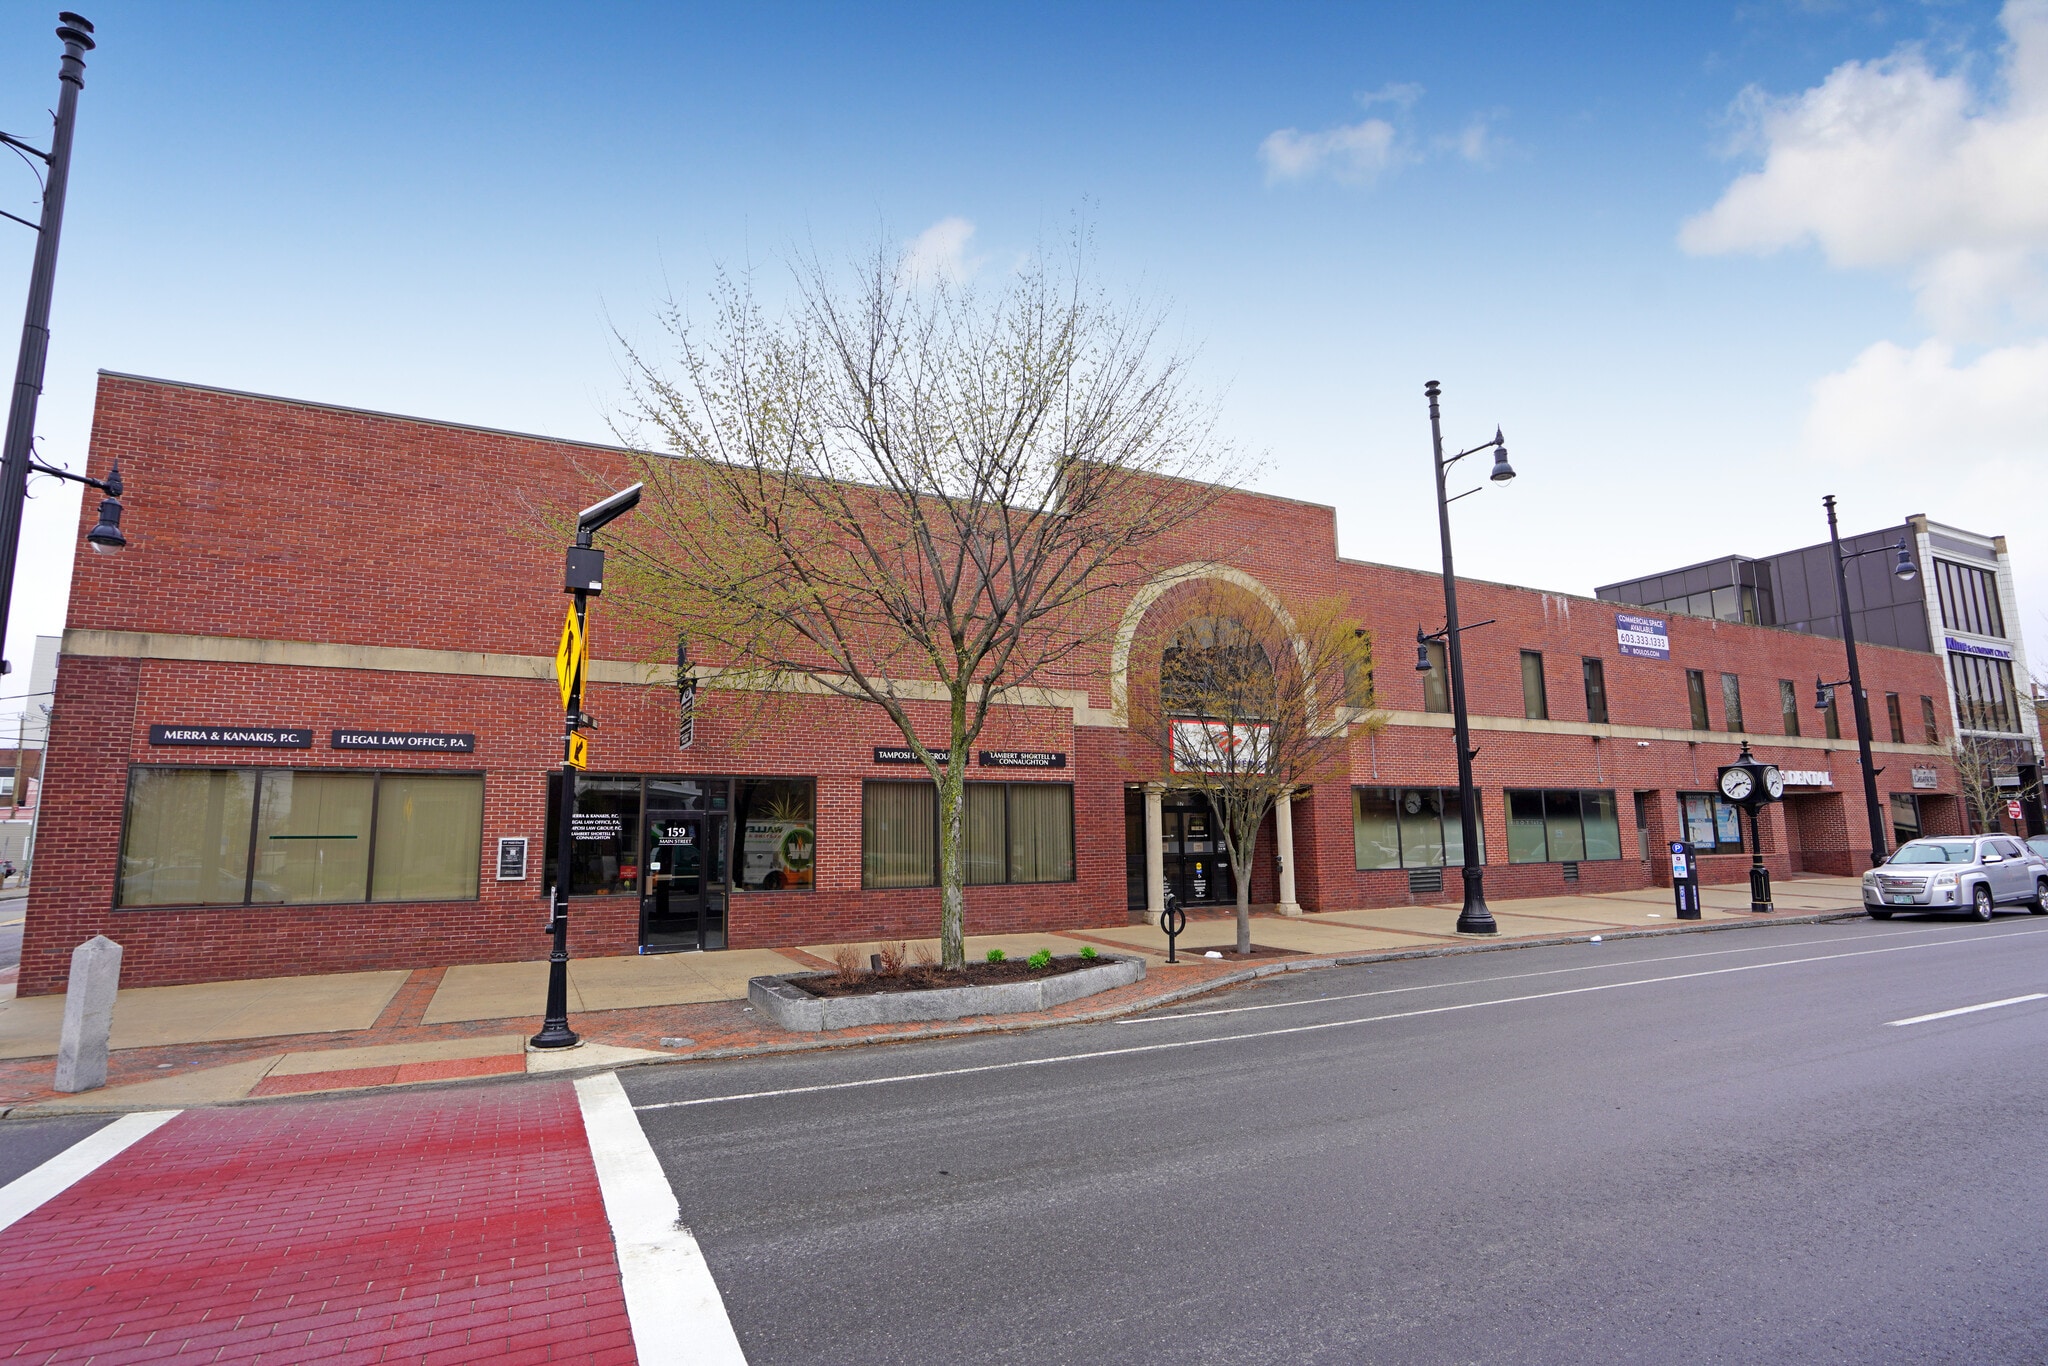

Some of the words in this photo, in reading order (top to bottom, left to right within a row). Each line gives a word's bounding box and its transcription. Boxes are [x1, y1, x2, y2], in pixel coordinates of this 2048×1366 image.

[1618, 614, 1649, 626] COMMERCIAL
[1649, 619, 1664, 628] SPACE
[1630, 624, 1654, 633] AVAILABLE
[1620, 633, 1666, 648] 603.333.1333
[164, 730, 207, 740] MERRA
[210, 732, 220, 741] &
[223, 732, 277, 743] KANAKIS,
[280, 734, 300, 743] P.C.
[340, 735, 379, 745] FLEGAL
[382, 736, 405, 745] LAW
[407, 737, 447, 748] OFFICE,
[450, 738, 467, 747] P.A.
[878, 751, 910, 759] TAMPOSI
[990, 752, 1018, 760] LAMBERT
[1789, 770, 1833, 786] DENTAL
[667, 827, 686, 837] 159
